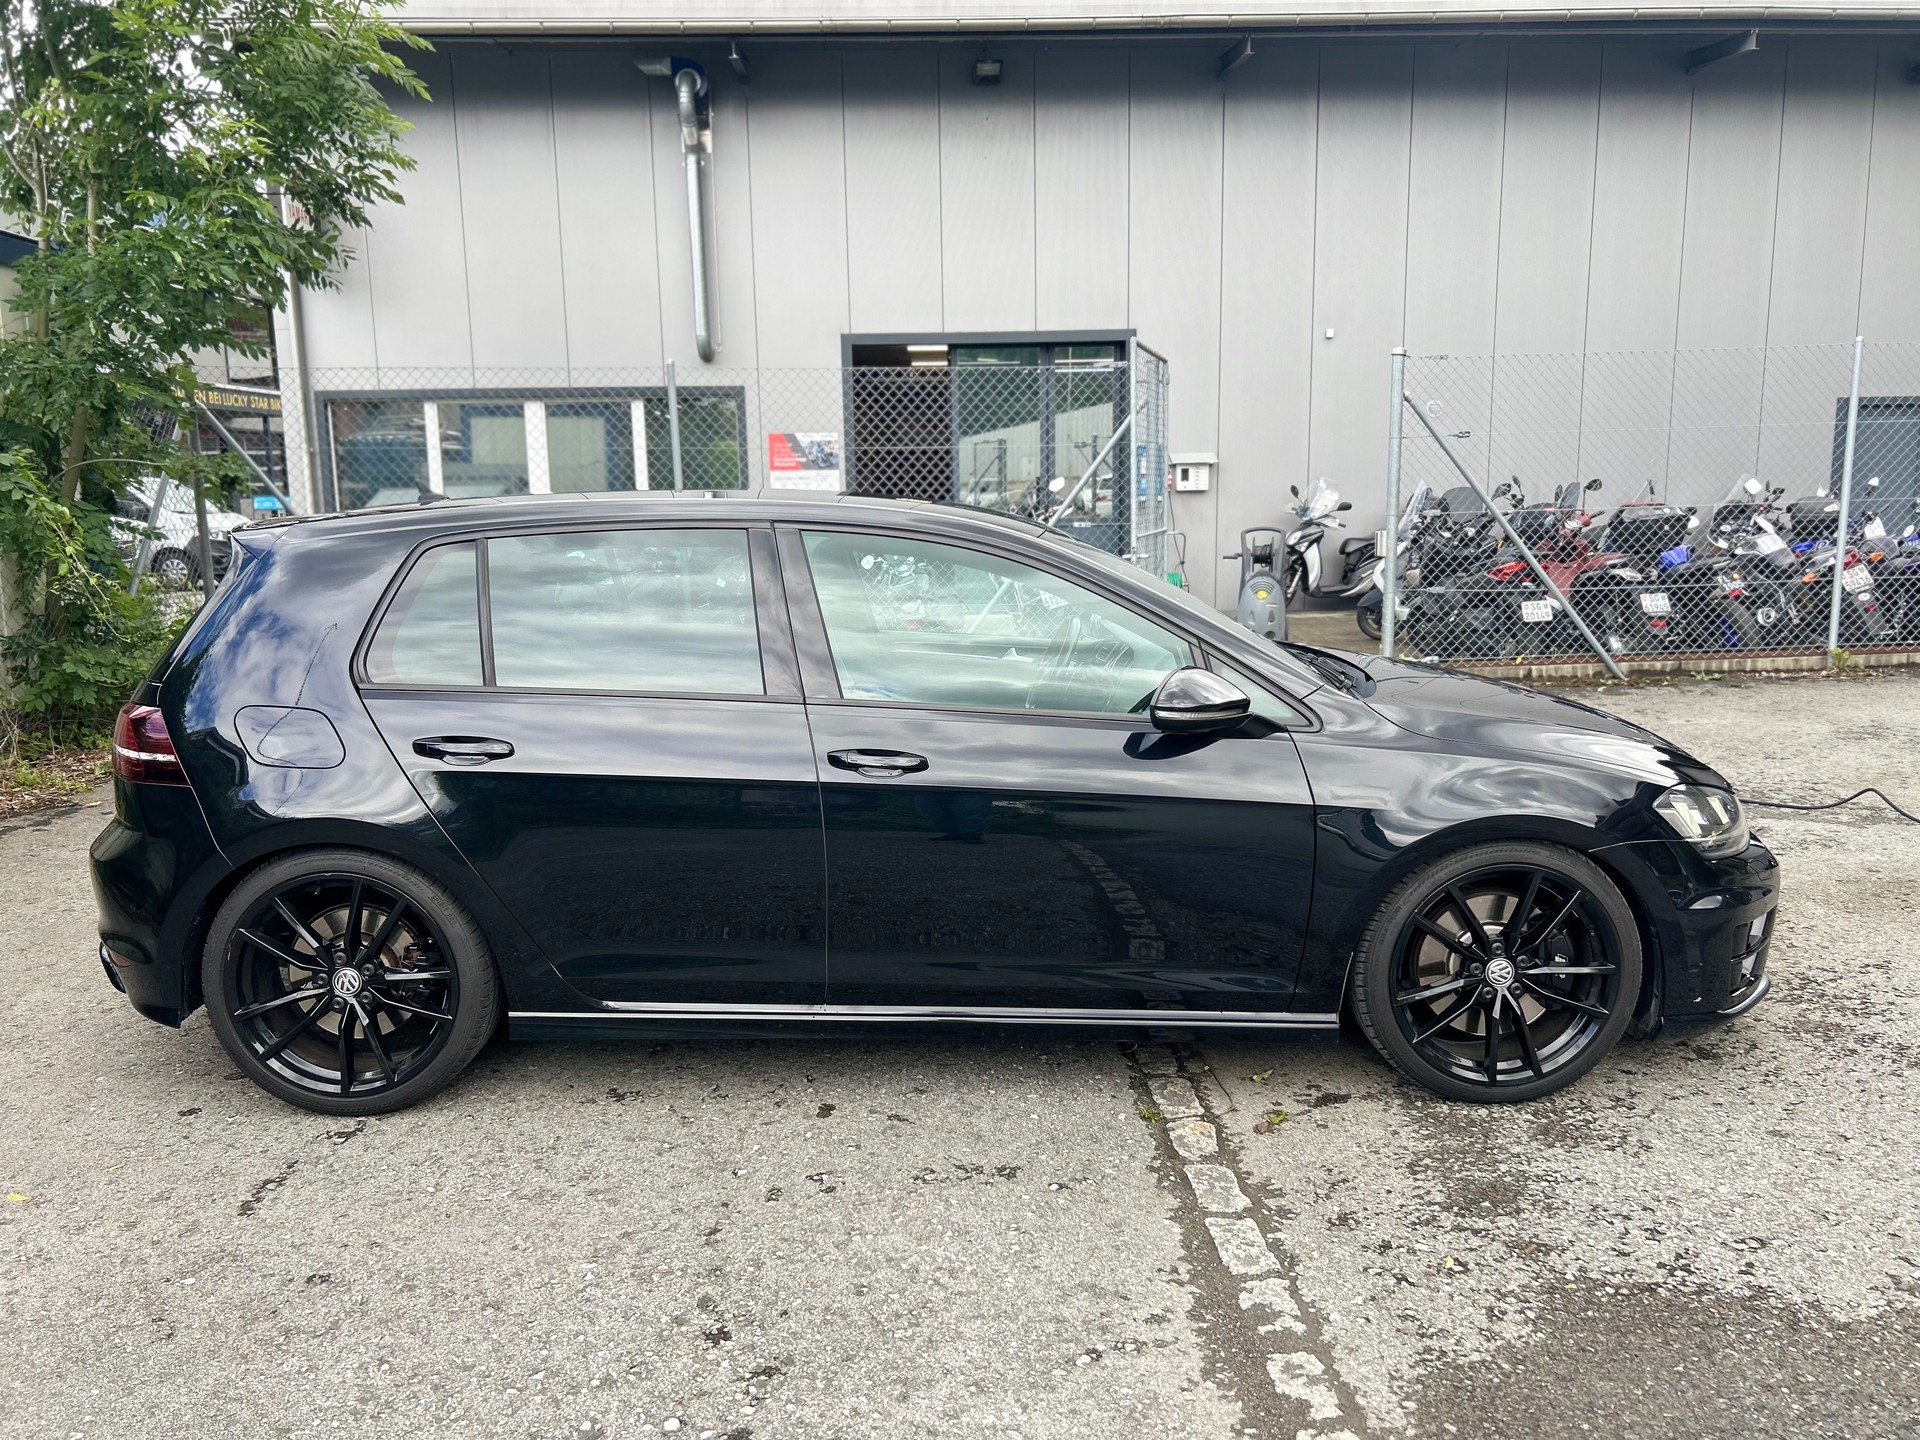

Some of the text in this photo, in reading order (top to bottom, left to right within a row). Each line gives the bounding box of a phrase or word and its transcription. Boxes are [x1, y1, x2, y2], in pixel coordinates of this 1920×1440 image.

[288, 202, 310, 226] YAMAH
[208, 391, 221, 405] BEI
[223, 393, 248, 408] LUCKY
[251, 396, 269, 410] STAR
[271, 398, 281, 412] BIK
[1847, 569, 1859, 578] SG
[1717, 575, 1730, 584] FL
[1845, 575, 1872, 589] 59416
[1649, 594, 1659, 603] SG
[1530, 602, 1542, 611] SG
[1644, 603, 1669, 611] 61945
[1525, 611, 1550, 620] 20149
[431, 895, 449, 912] SPIRIT
